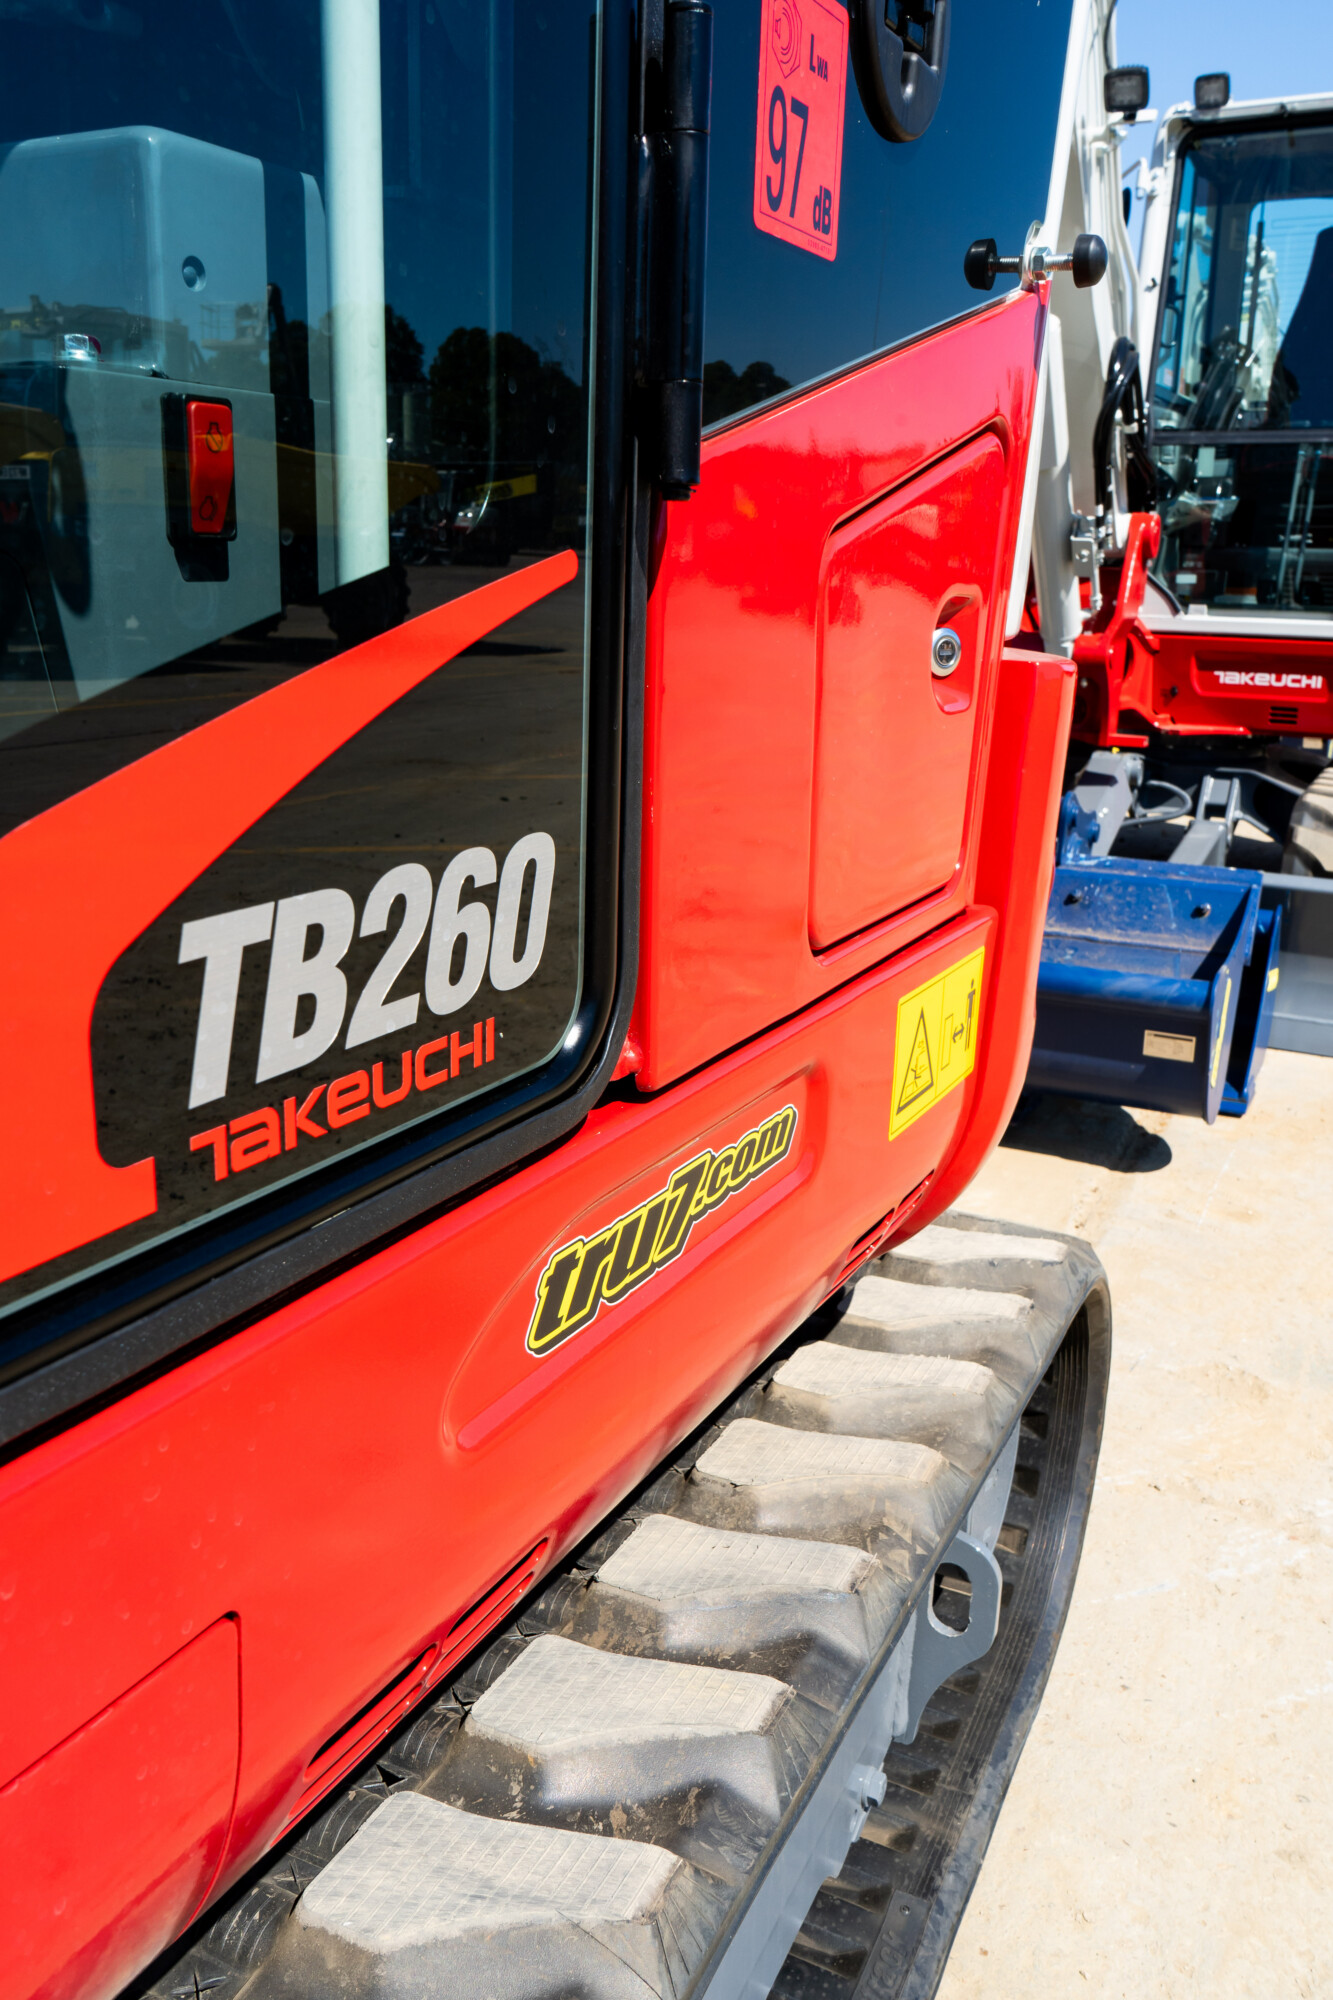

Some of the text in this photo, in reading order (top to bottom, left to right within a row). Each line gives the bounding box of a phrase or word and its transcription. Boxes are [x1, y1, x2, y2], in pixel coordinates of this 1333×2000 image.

[766, 85, 809, 218] 97
[813, 185, 832, 236] dB
[178, 832, 556, 1110] TB260
[526, 1104, 797, 1356] tru7.com
